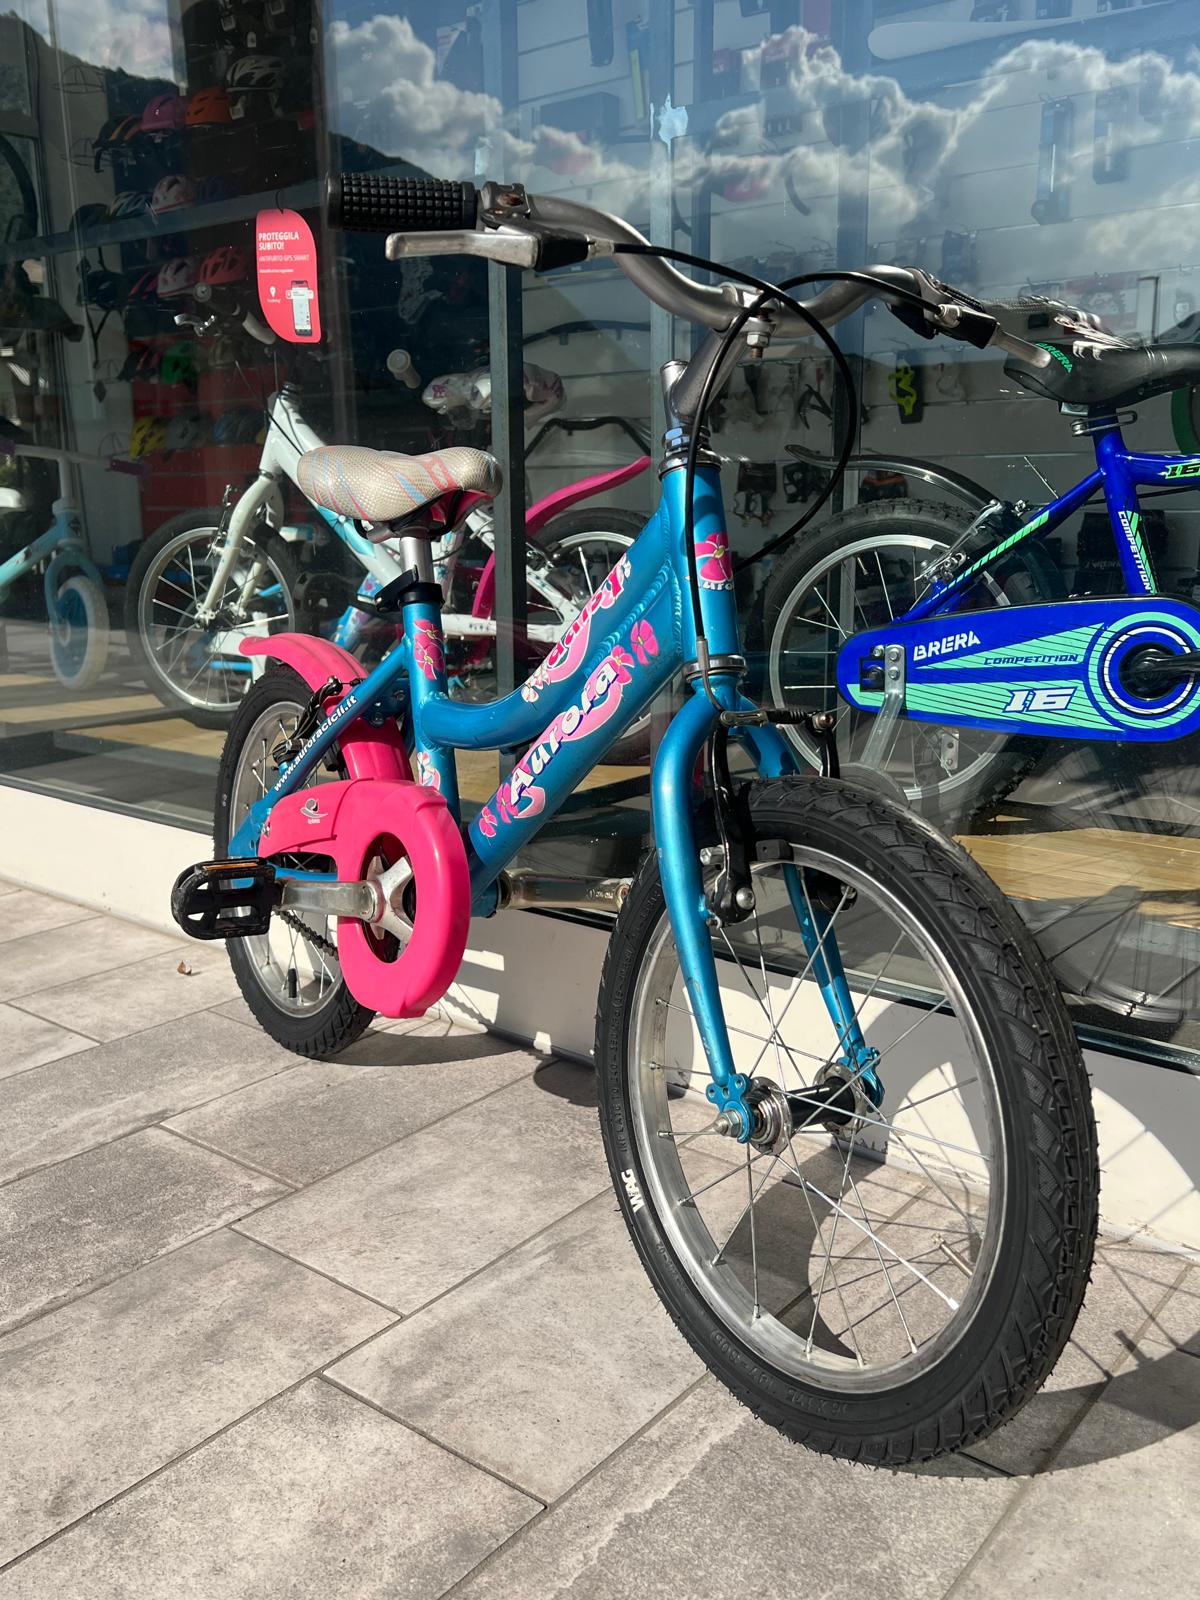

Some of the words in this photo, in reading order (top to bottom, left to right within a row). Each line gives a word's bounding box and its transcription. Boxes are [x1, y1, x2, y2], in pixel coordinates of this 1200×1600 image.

[258, 231, 300, 241] PROTEGGILA
[1117, 510, 1152, 592] COMPETITION
[913, 630, 981, 662] BRERA
[984, 653, 1079, 666] COMPETITION
[1002, 686, 1079, 713] 16
[273, 694, 358, 792] www.auroracicli.it
[510, 662, 619, 808] Aurora
[620, 1167, 646, 1214] WAG
